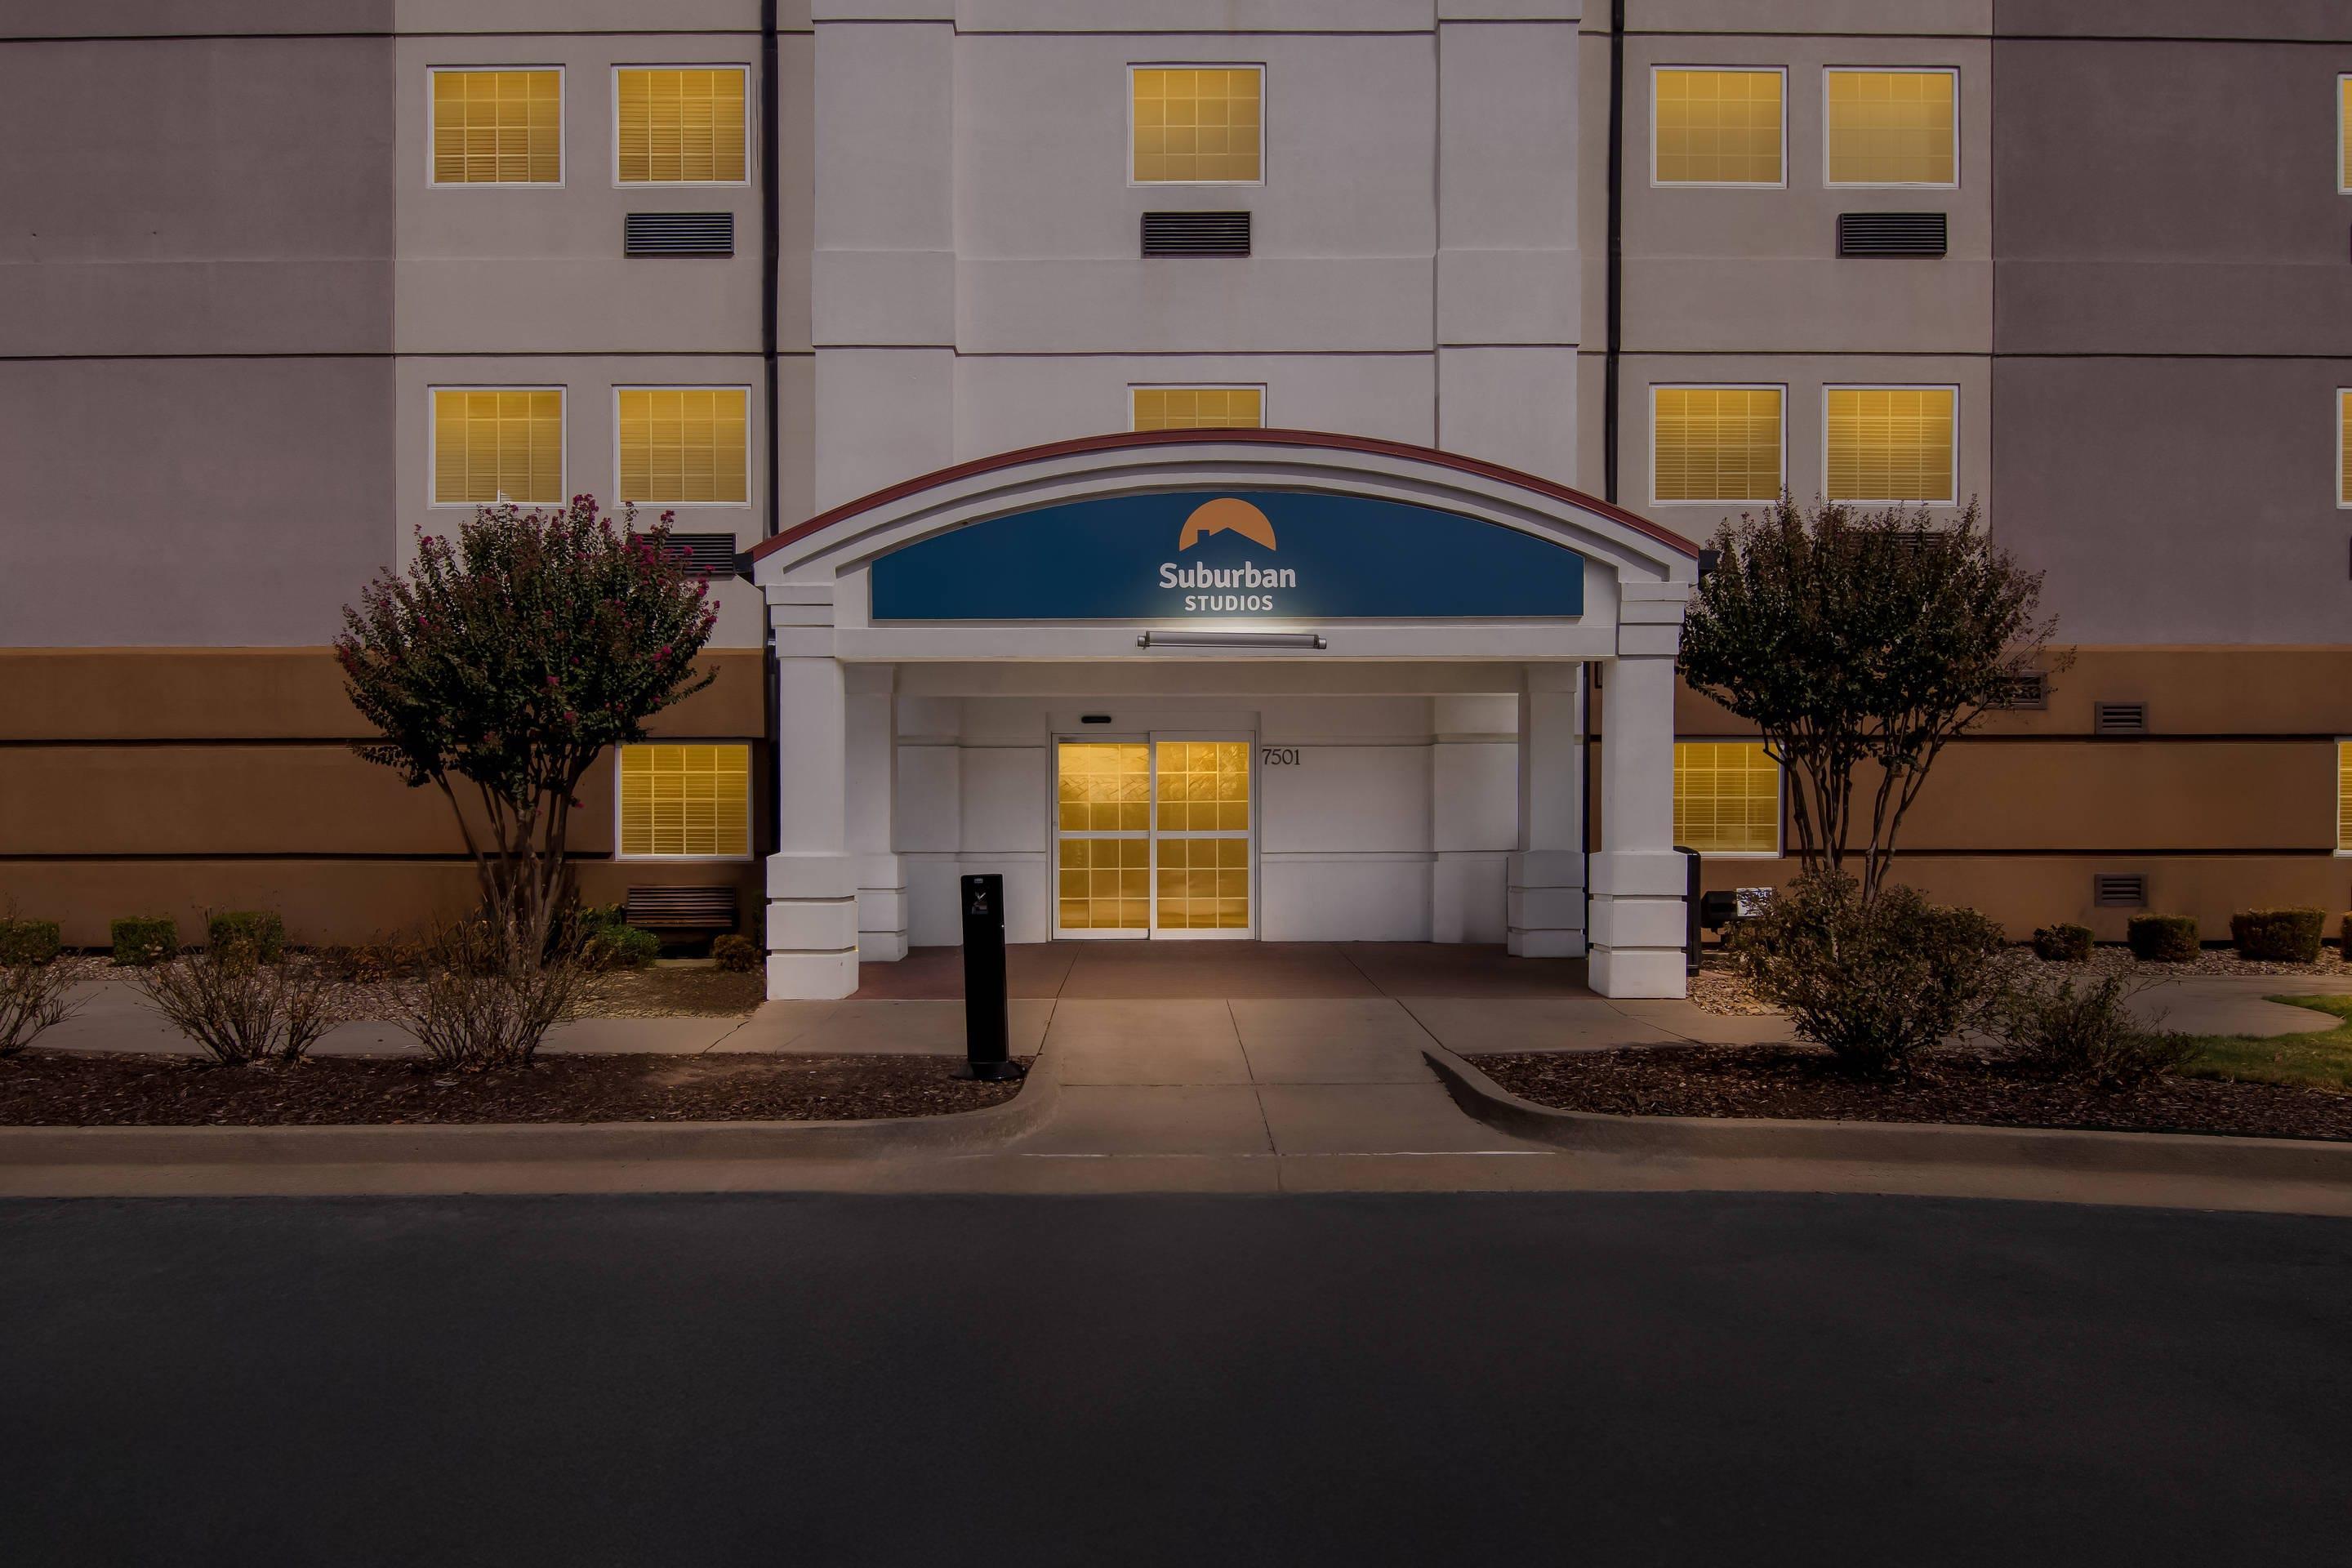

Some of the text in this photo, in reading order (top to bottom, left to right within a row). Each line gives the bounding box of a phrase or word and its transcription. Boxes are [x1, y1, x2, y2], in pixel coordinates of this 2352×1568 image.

[1159, 561, 1296, 589] Suburban
[1184, 595, 1273, 611] STUDIOS
[1262, 748, 1301, 765] 7501
